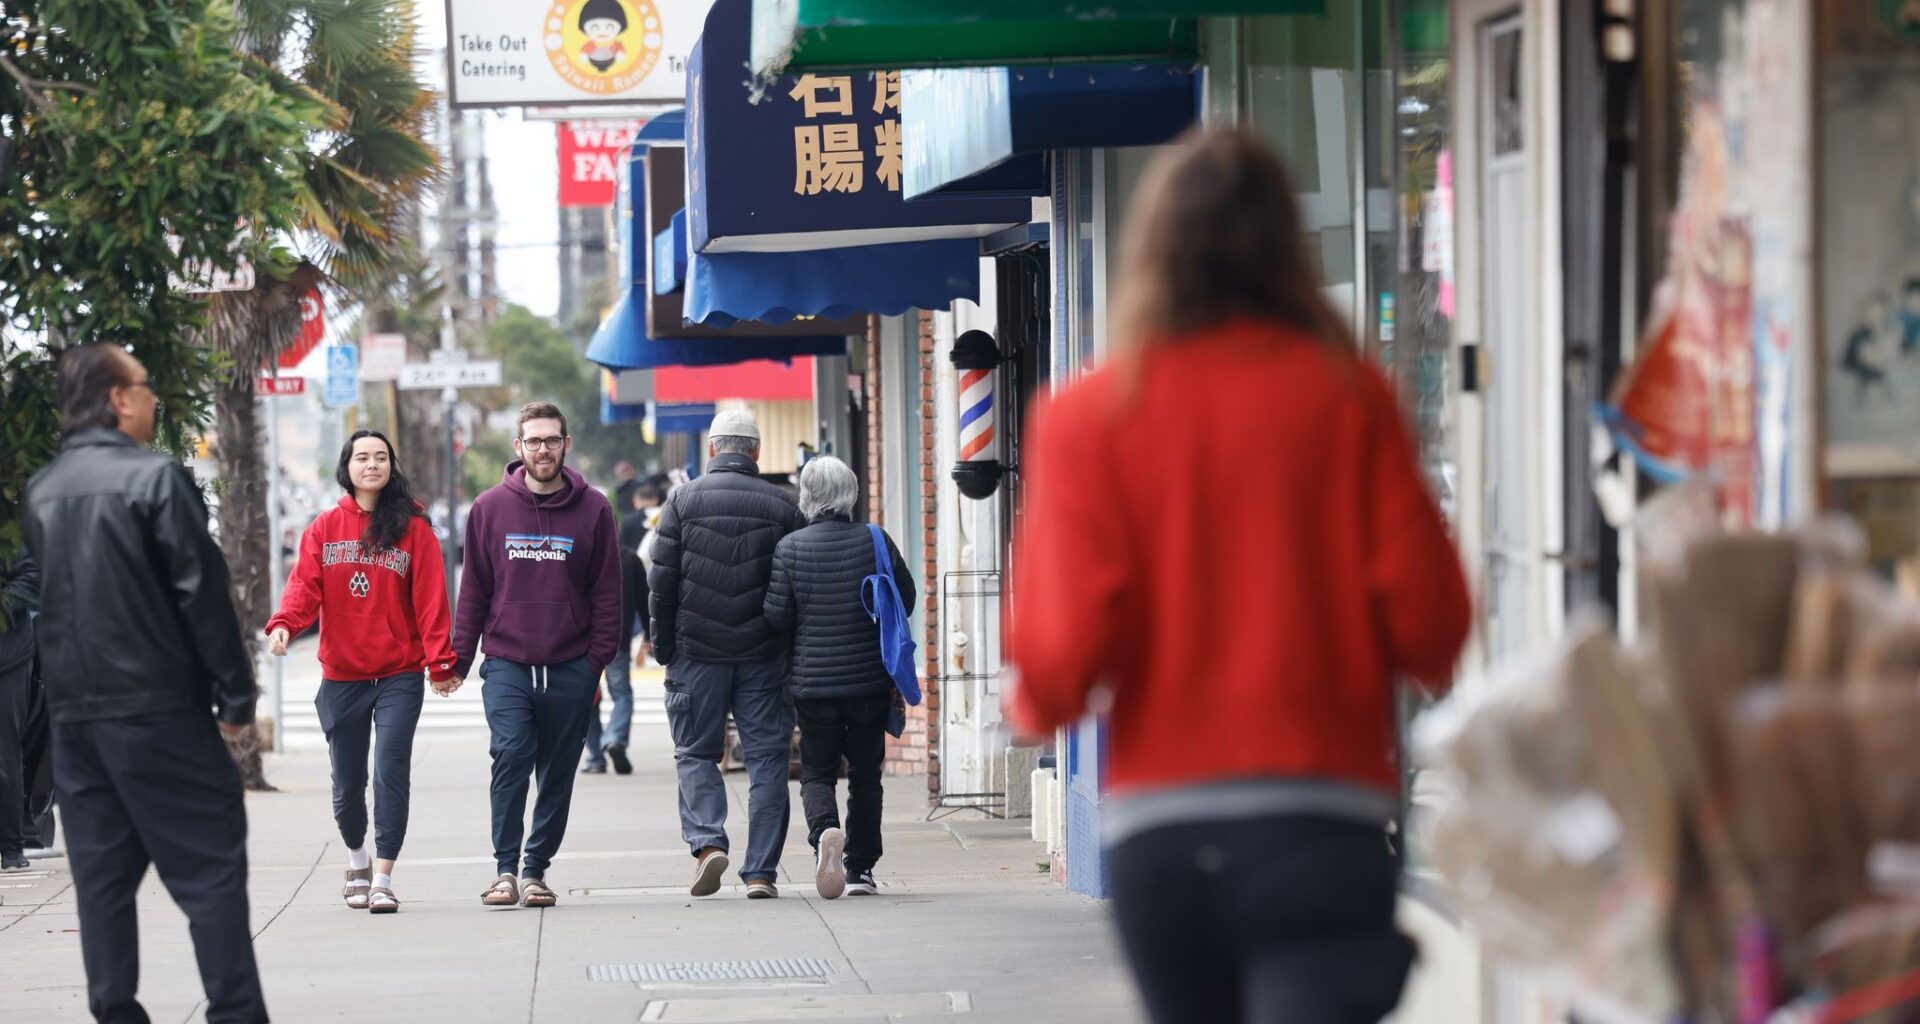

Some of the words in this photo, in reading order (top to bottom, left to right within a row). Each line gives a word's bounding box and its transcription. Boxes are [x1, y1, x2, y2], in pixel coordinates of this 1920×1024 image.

[460, 34, 492, 51] Take
[500, 34, 527, 51] Out
[462, 59, 526, 81] Catering
[612, 51, 657, 92] Ramen
[274, 379, 300, 393] WAY
[508, 549, 566, 561] patagonia
